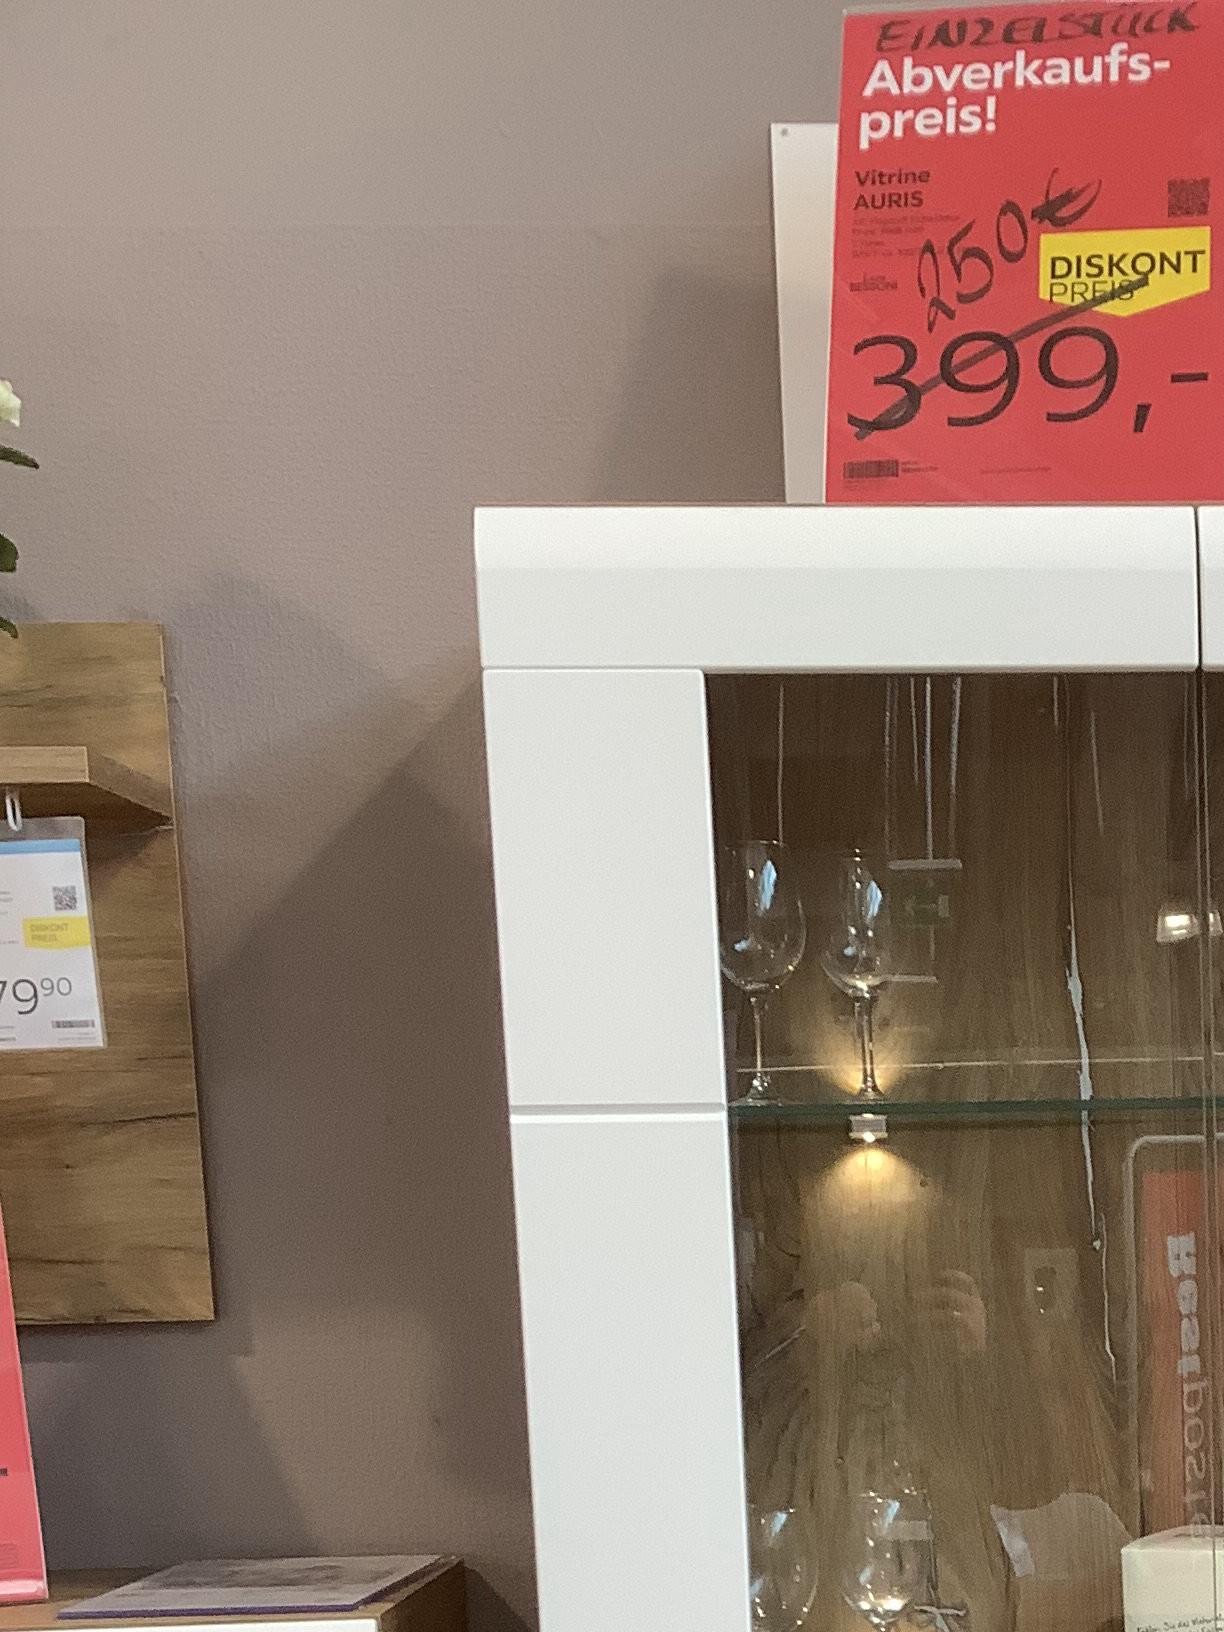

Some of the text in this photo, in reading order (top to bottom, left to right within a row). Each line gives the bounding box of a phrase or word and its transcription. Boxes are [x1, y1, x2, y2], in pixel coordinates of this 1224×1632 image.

[863, 43, 1171, 97] Abverkaufs-
[859, 96, 997, 150] preis!
[854, 168, 930, 187] Vitrine
[853, 190, 924, 211] AURIS
[917, 168, 1101, 332] 250€
[1049, 250, 1206, 281] DISKONT
[1049, 278, 1134, 304] PREIS
[847, 326, 1208, 437] 399,-
